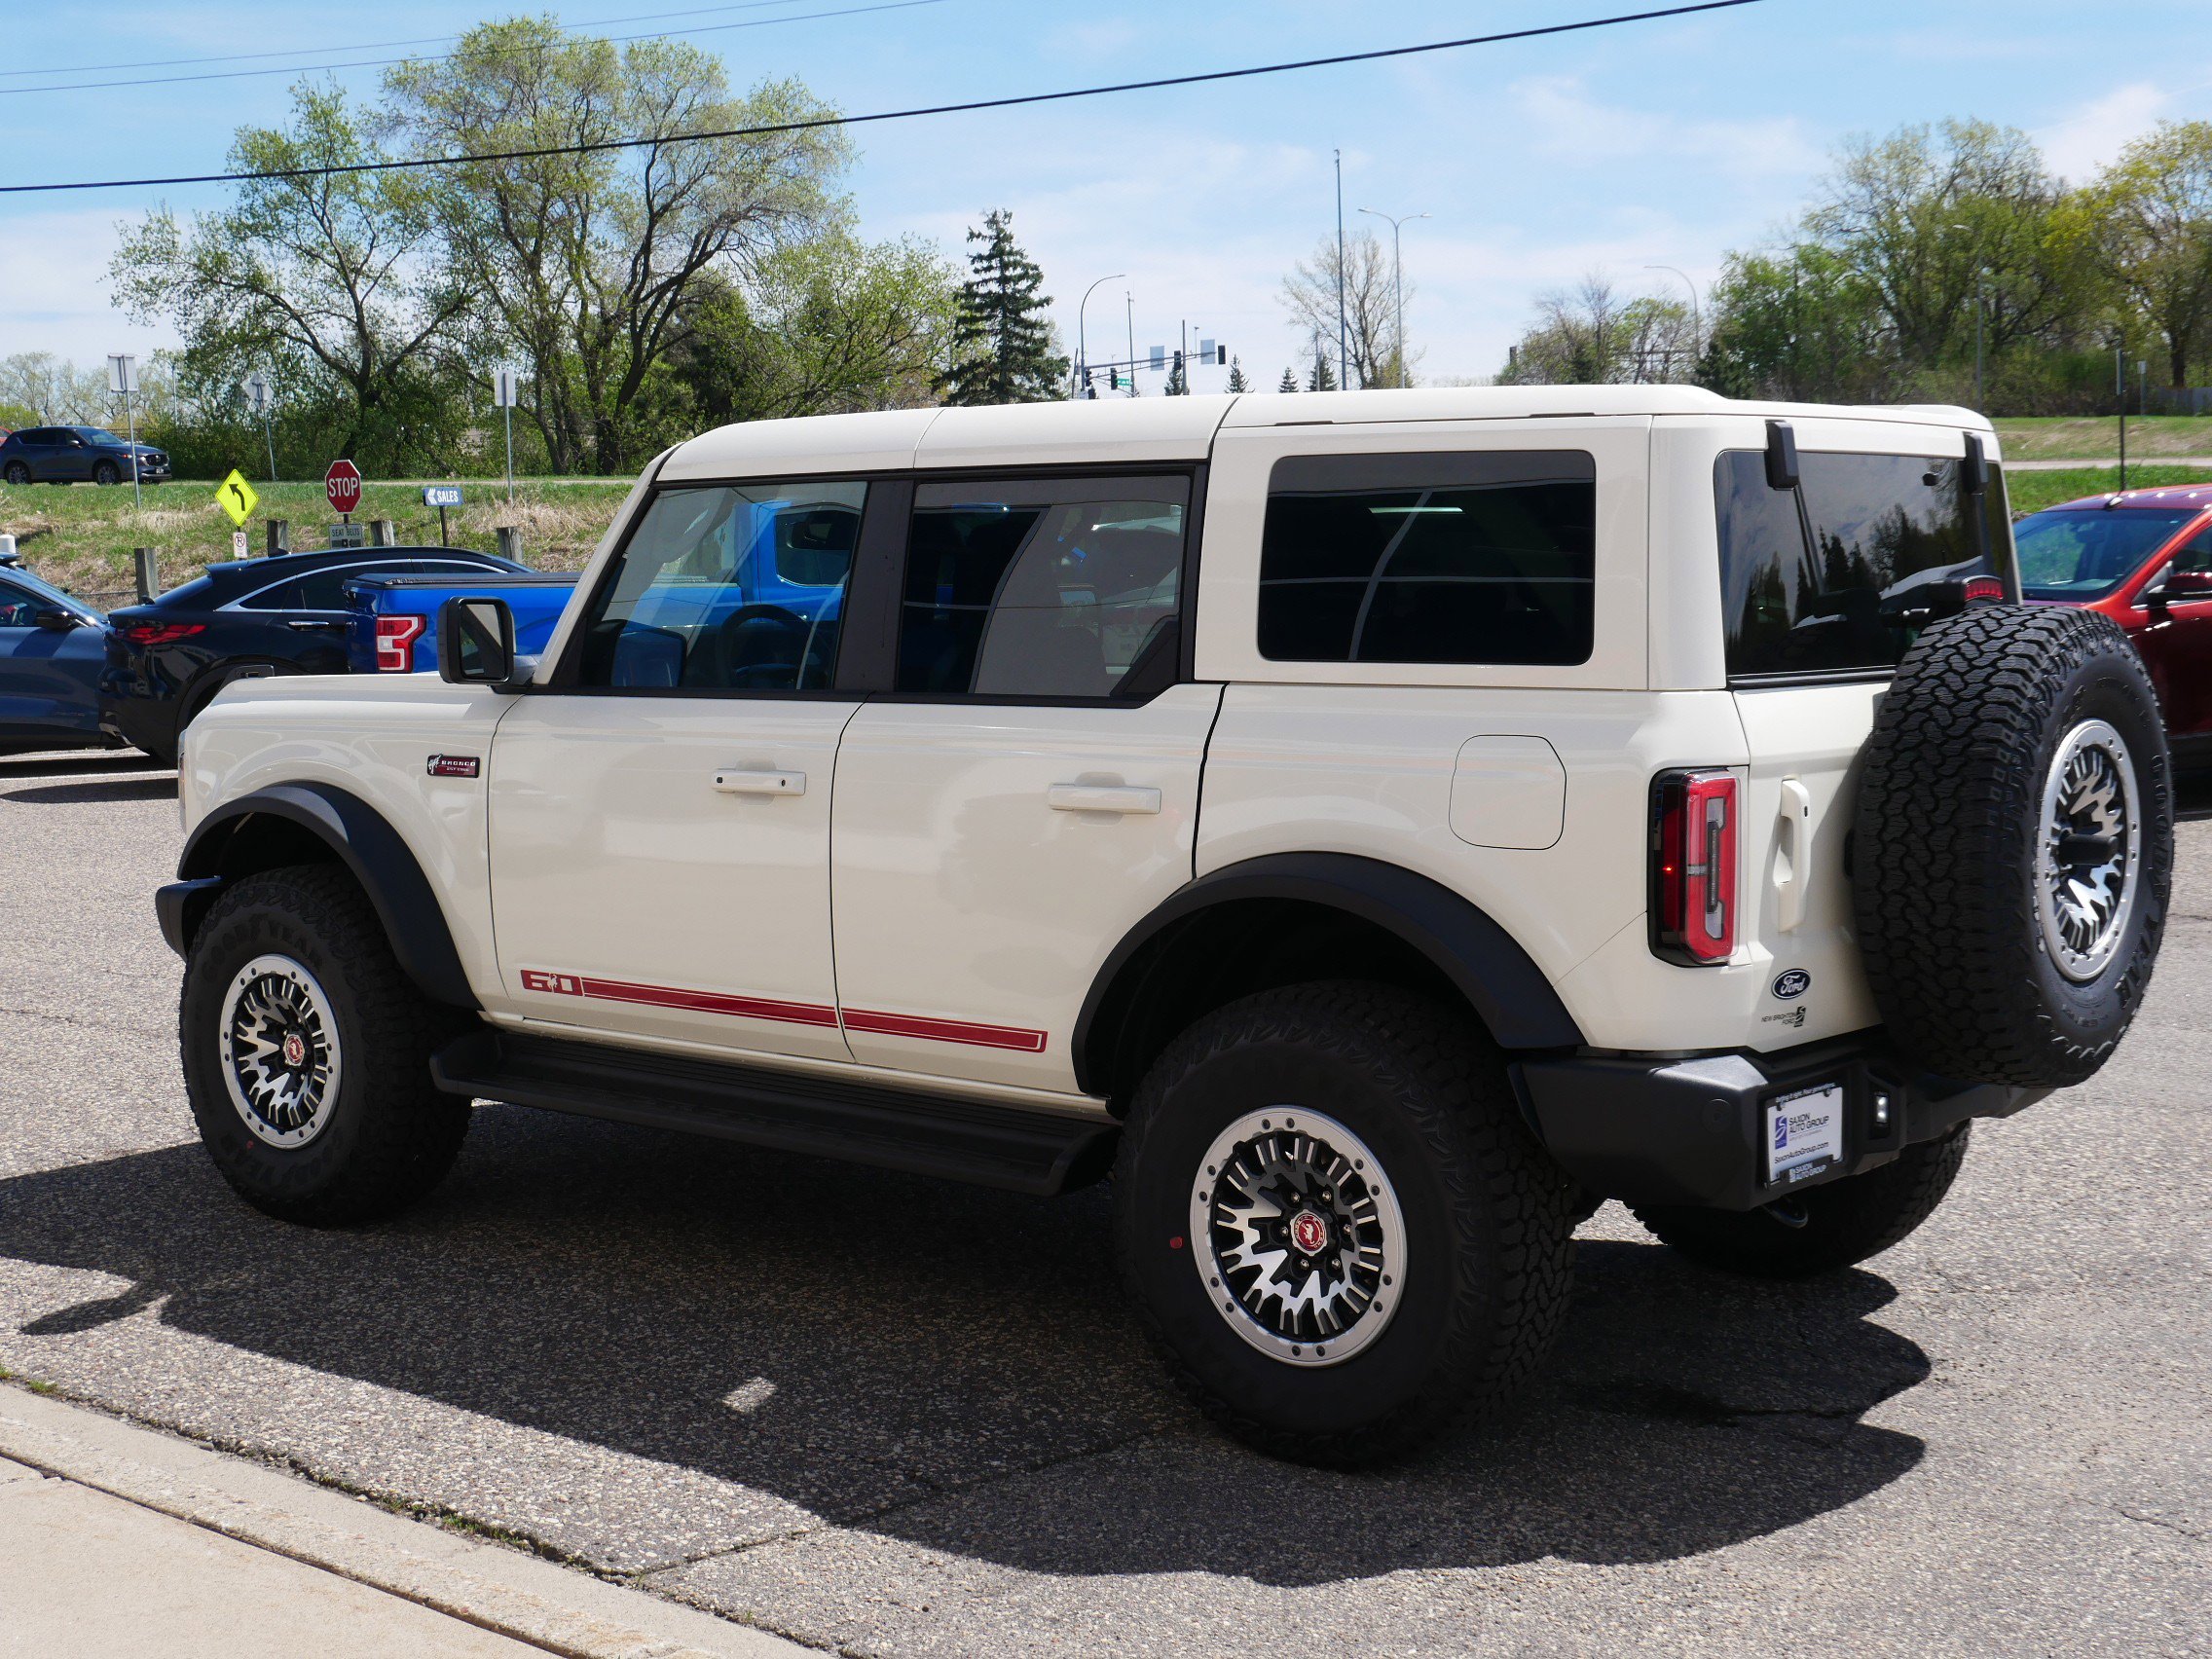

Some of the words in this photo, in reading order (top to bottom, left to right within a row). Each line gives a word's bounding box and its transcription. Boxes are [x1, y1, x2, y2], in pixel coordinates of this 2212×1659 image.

[328, 477, 358, 498] STOP
[436, 490, 459, 502] SALES
[346, 528, 360, 536] BELTS
[1780, 974, 1807, 994] Ford
[1788, 1113, 1811, 1126] SAXON
[1788, 1122, 1806, 1133] AUTO
[1806, 1115, 1829, 1129] GROUP
[1774, 1141, 1829, 1163] SaxonAutoGroup.com
